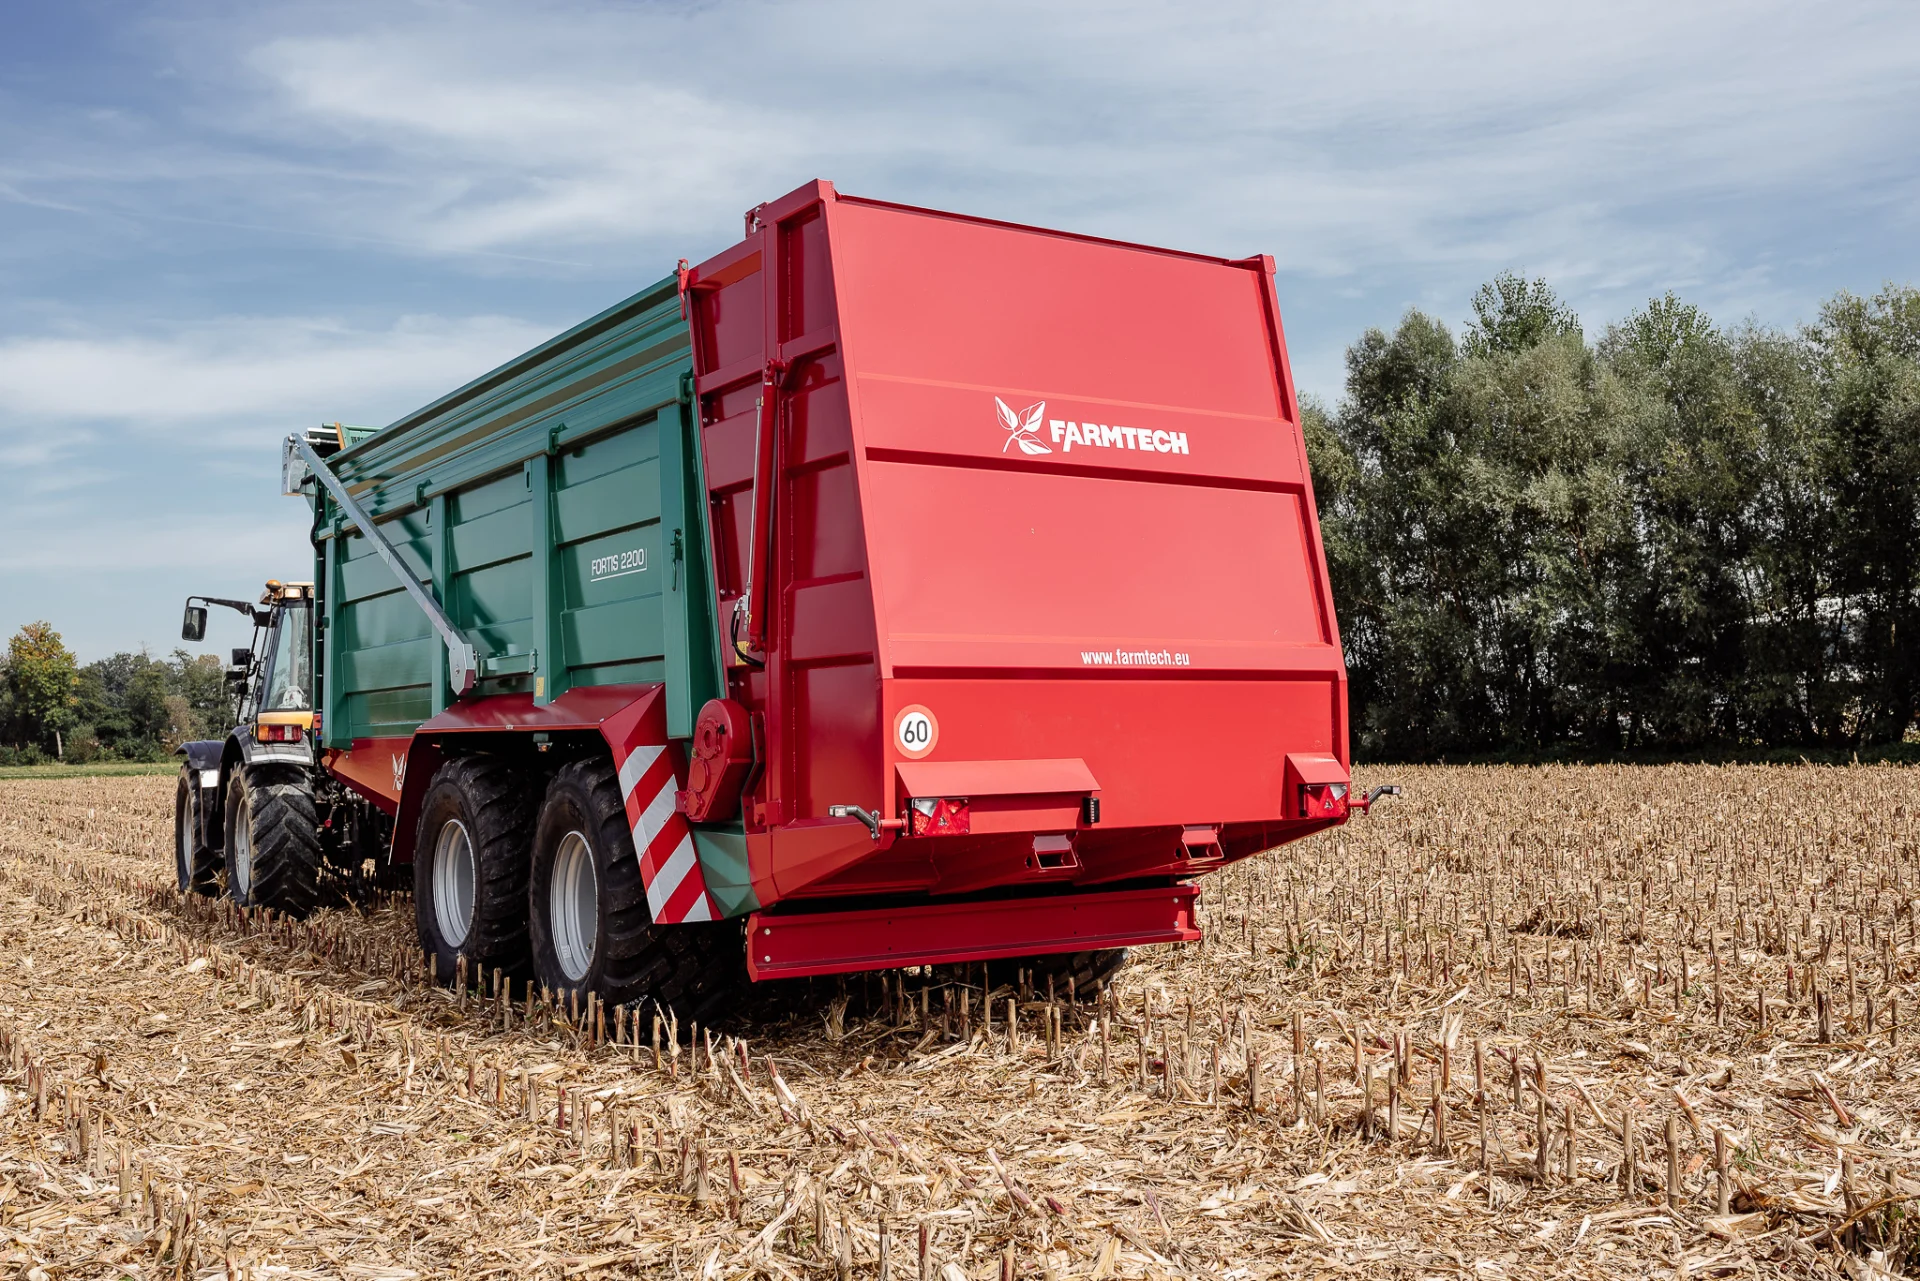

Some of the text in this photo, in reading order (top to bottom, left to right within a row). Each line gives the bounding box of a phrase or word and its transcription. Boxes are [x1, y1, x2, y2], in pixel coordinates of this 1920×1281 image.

[1049, 419, 1190, 455] FARMTECH
[591, 548, 644, 576] FORTIS 2200
[1080, 649, 1190, 666] www.farmtech.eu
[904, 720, 928, 744] 60
